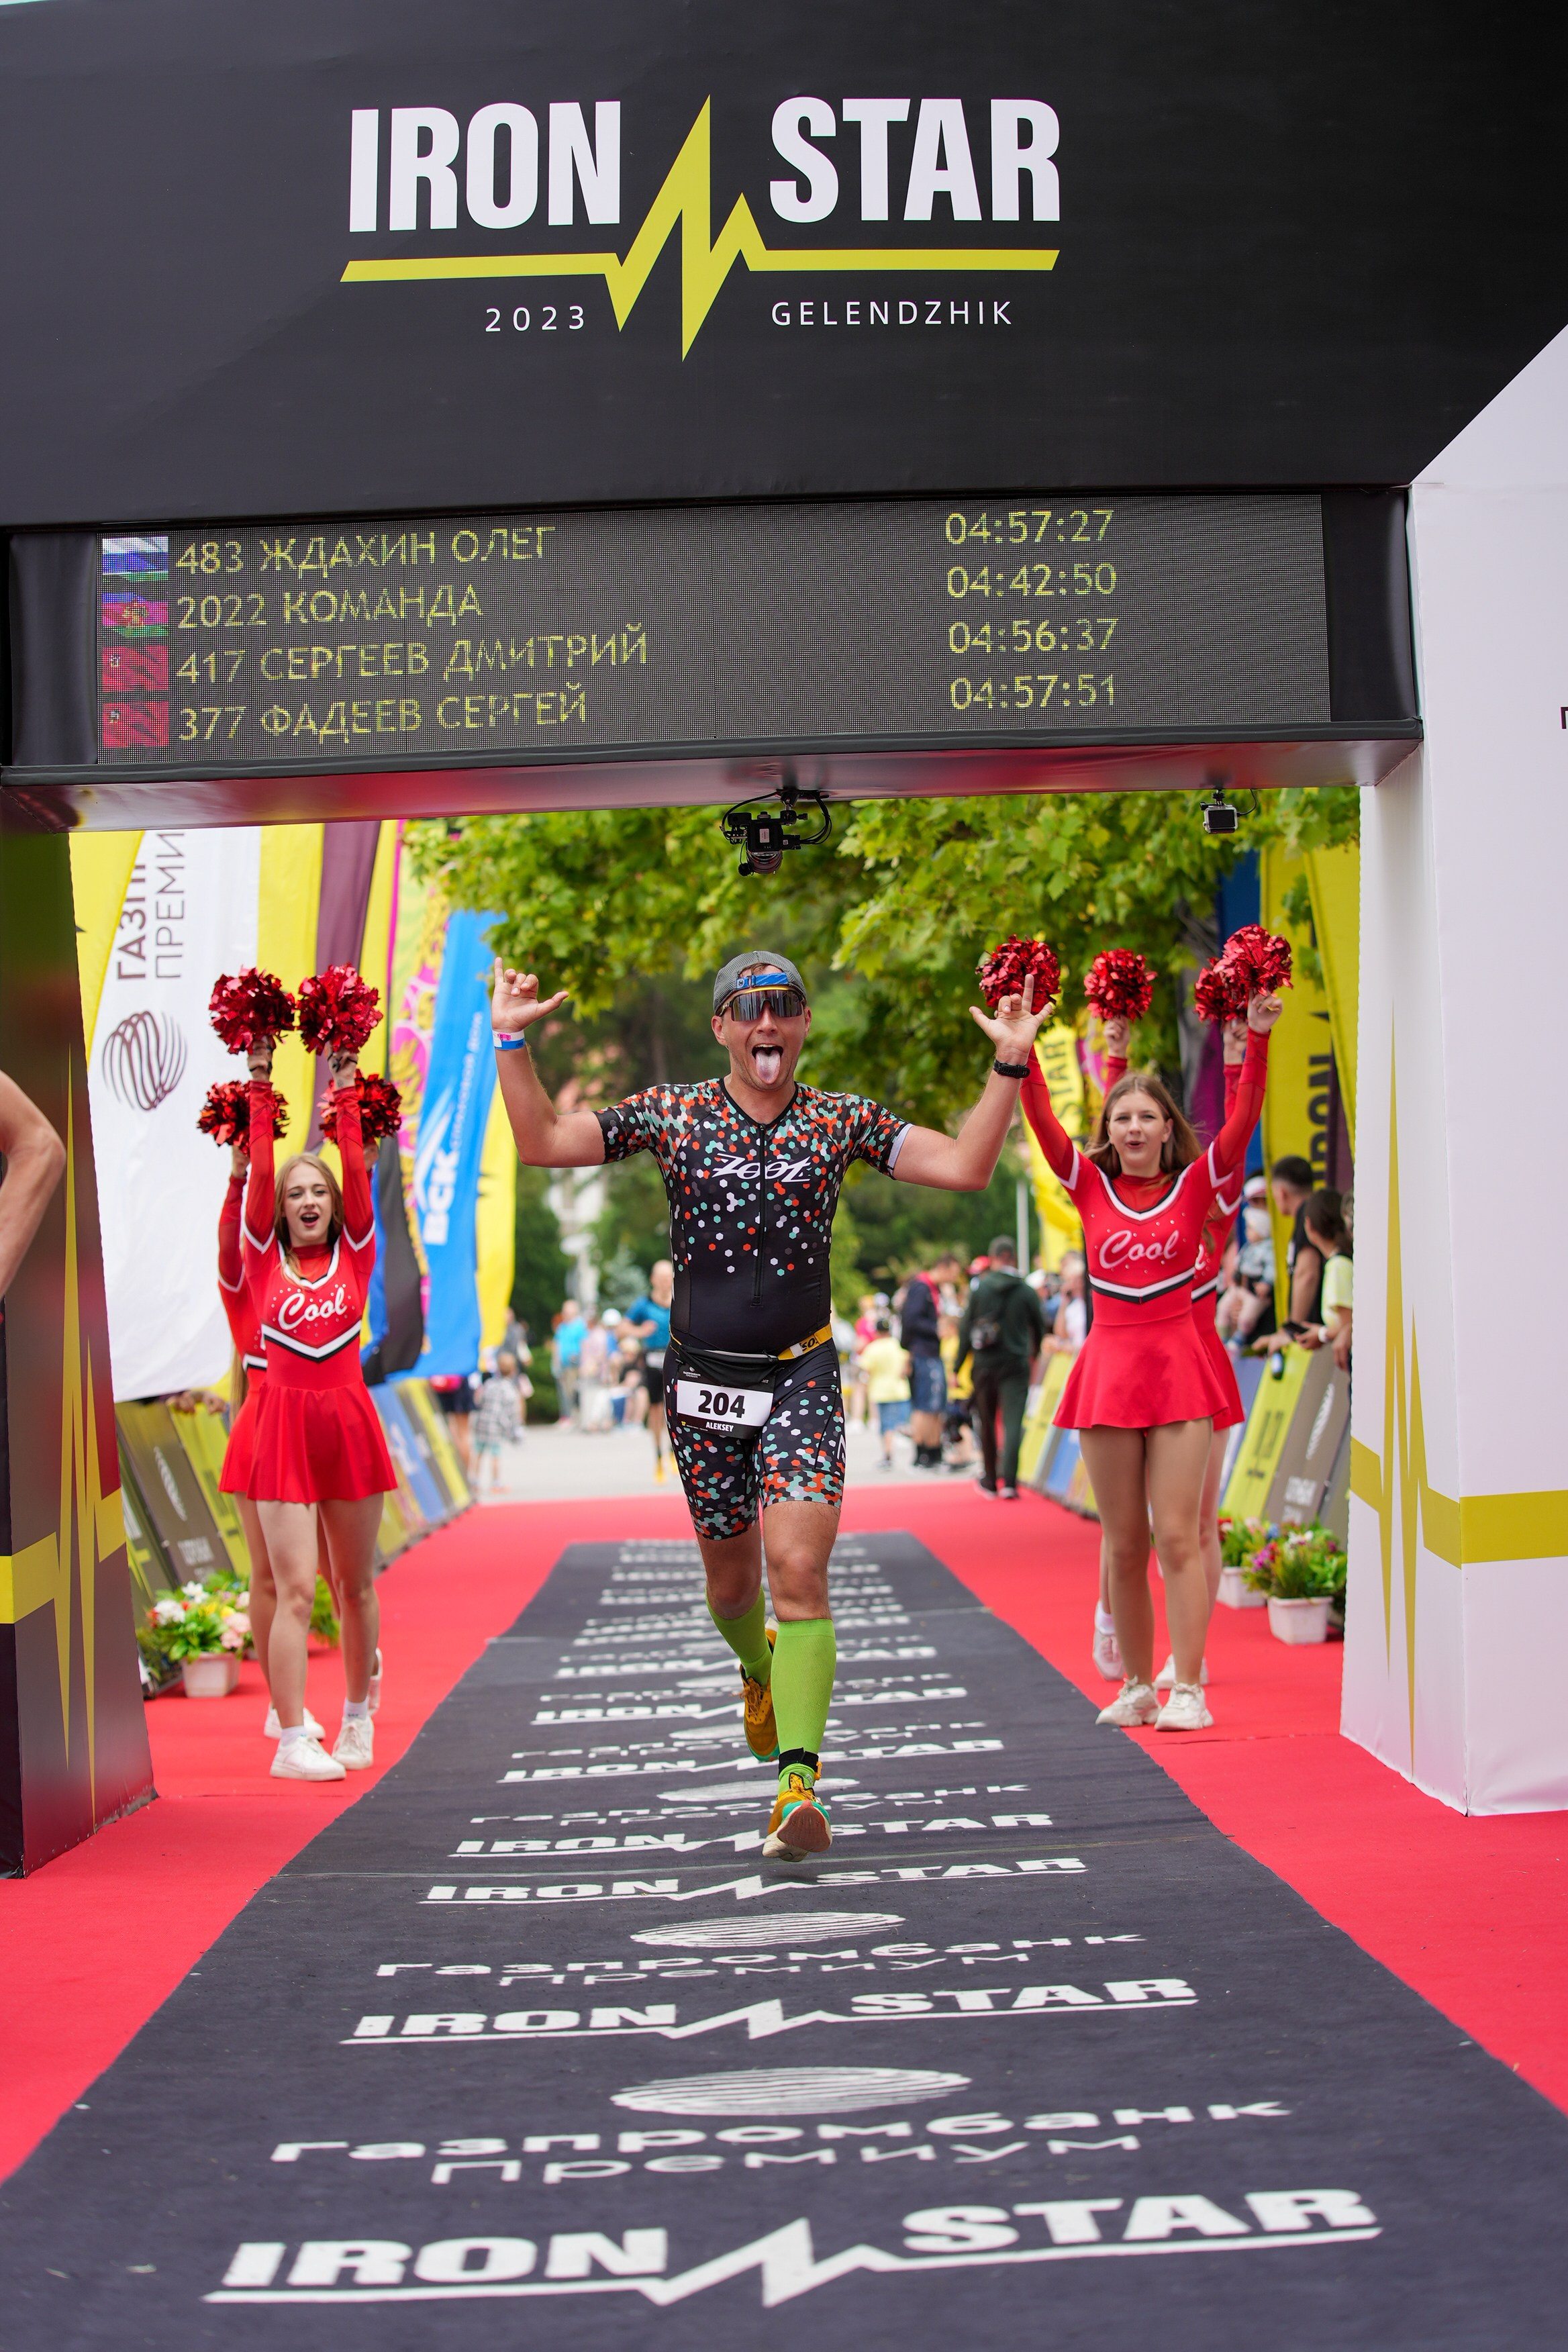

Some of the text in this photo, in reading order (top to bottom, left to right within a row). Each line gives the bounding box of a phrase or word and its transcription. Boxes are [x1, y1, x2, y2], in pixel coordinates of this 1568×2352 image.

[348, 97, 1061, 232] IRON STAR
[485, 305, 585, 333] 2023
[771, 301, 1012, 326] GELENDZHIK
[176, 509, 1114, 578] 483 ЖДАХИН ОЛЕГ 04:57:27
[176, 562, 1117, 629] 2022 КОМАНДА 04:42:50
[176, 618, 1119, 684] 417 СЕРГЕЕВ ДМИТРИЙ 04:56:37
[179, 674, 1114, 743] 377 ФАДЕЕВ СЕРГЕЙ 04:57:51
[1099, 1230, 1179, 1269] Cool
[278, 1287, 348, 1330] Cool
[698, 1389, 745, 1418] 204
[705, 1421, 734, 1432] ALEKSEY
[456, 1833, 685, 1853] IRON
[427, 1857, 1087, 1900] IRON STAR
[354, 1978, 1197, 2037] IRON STAR
[271, 2102, 1292, 2162] Газпромбанк
[431, 2135, 1140, 2184] Премиум
[222, 2188, 1378, 2287] IRON STAR
